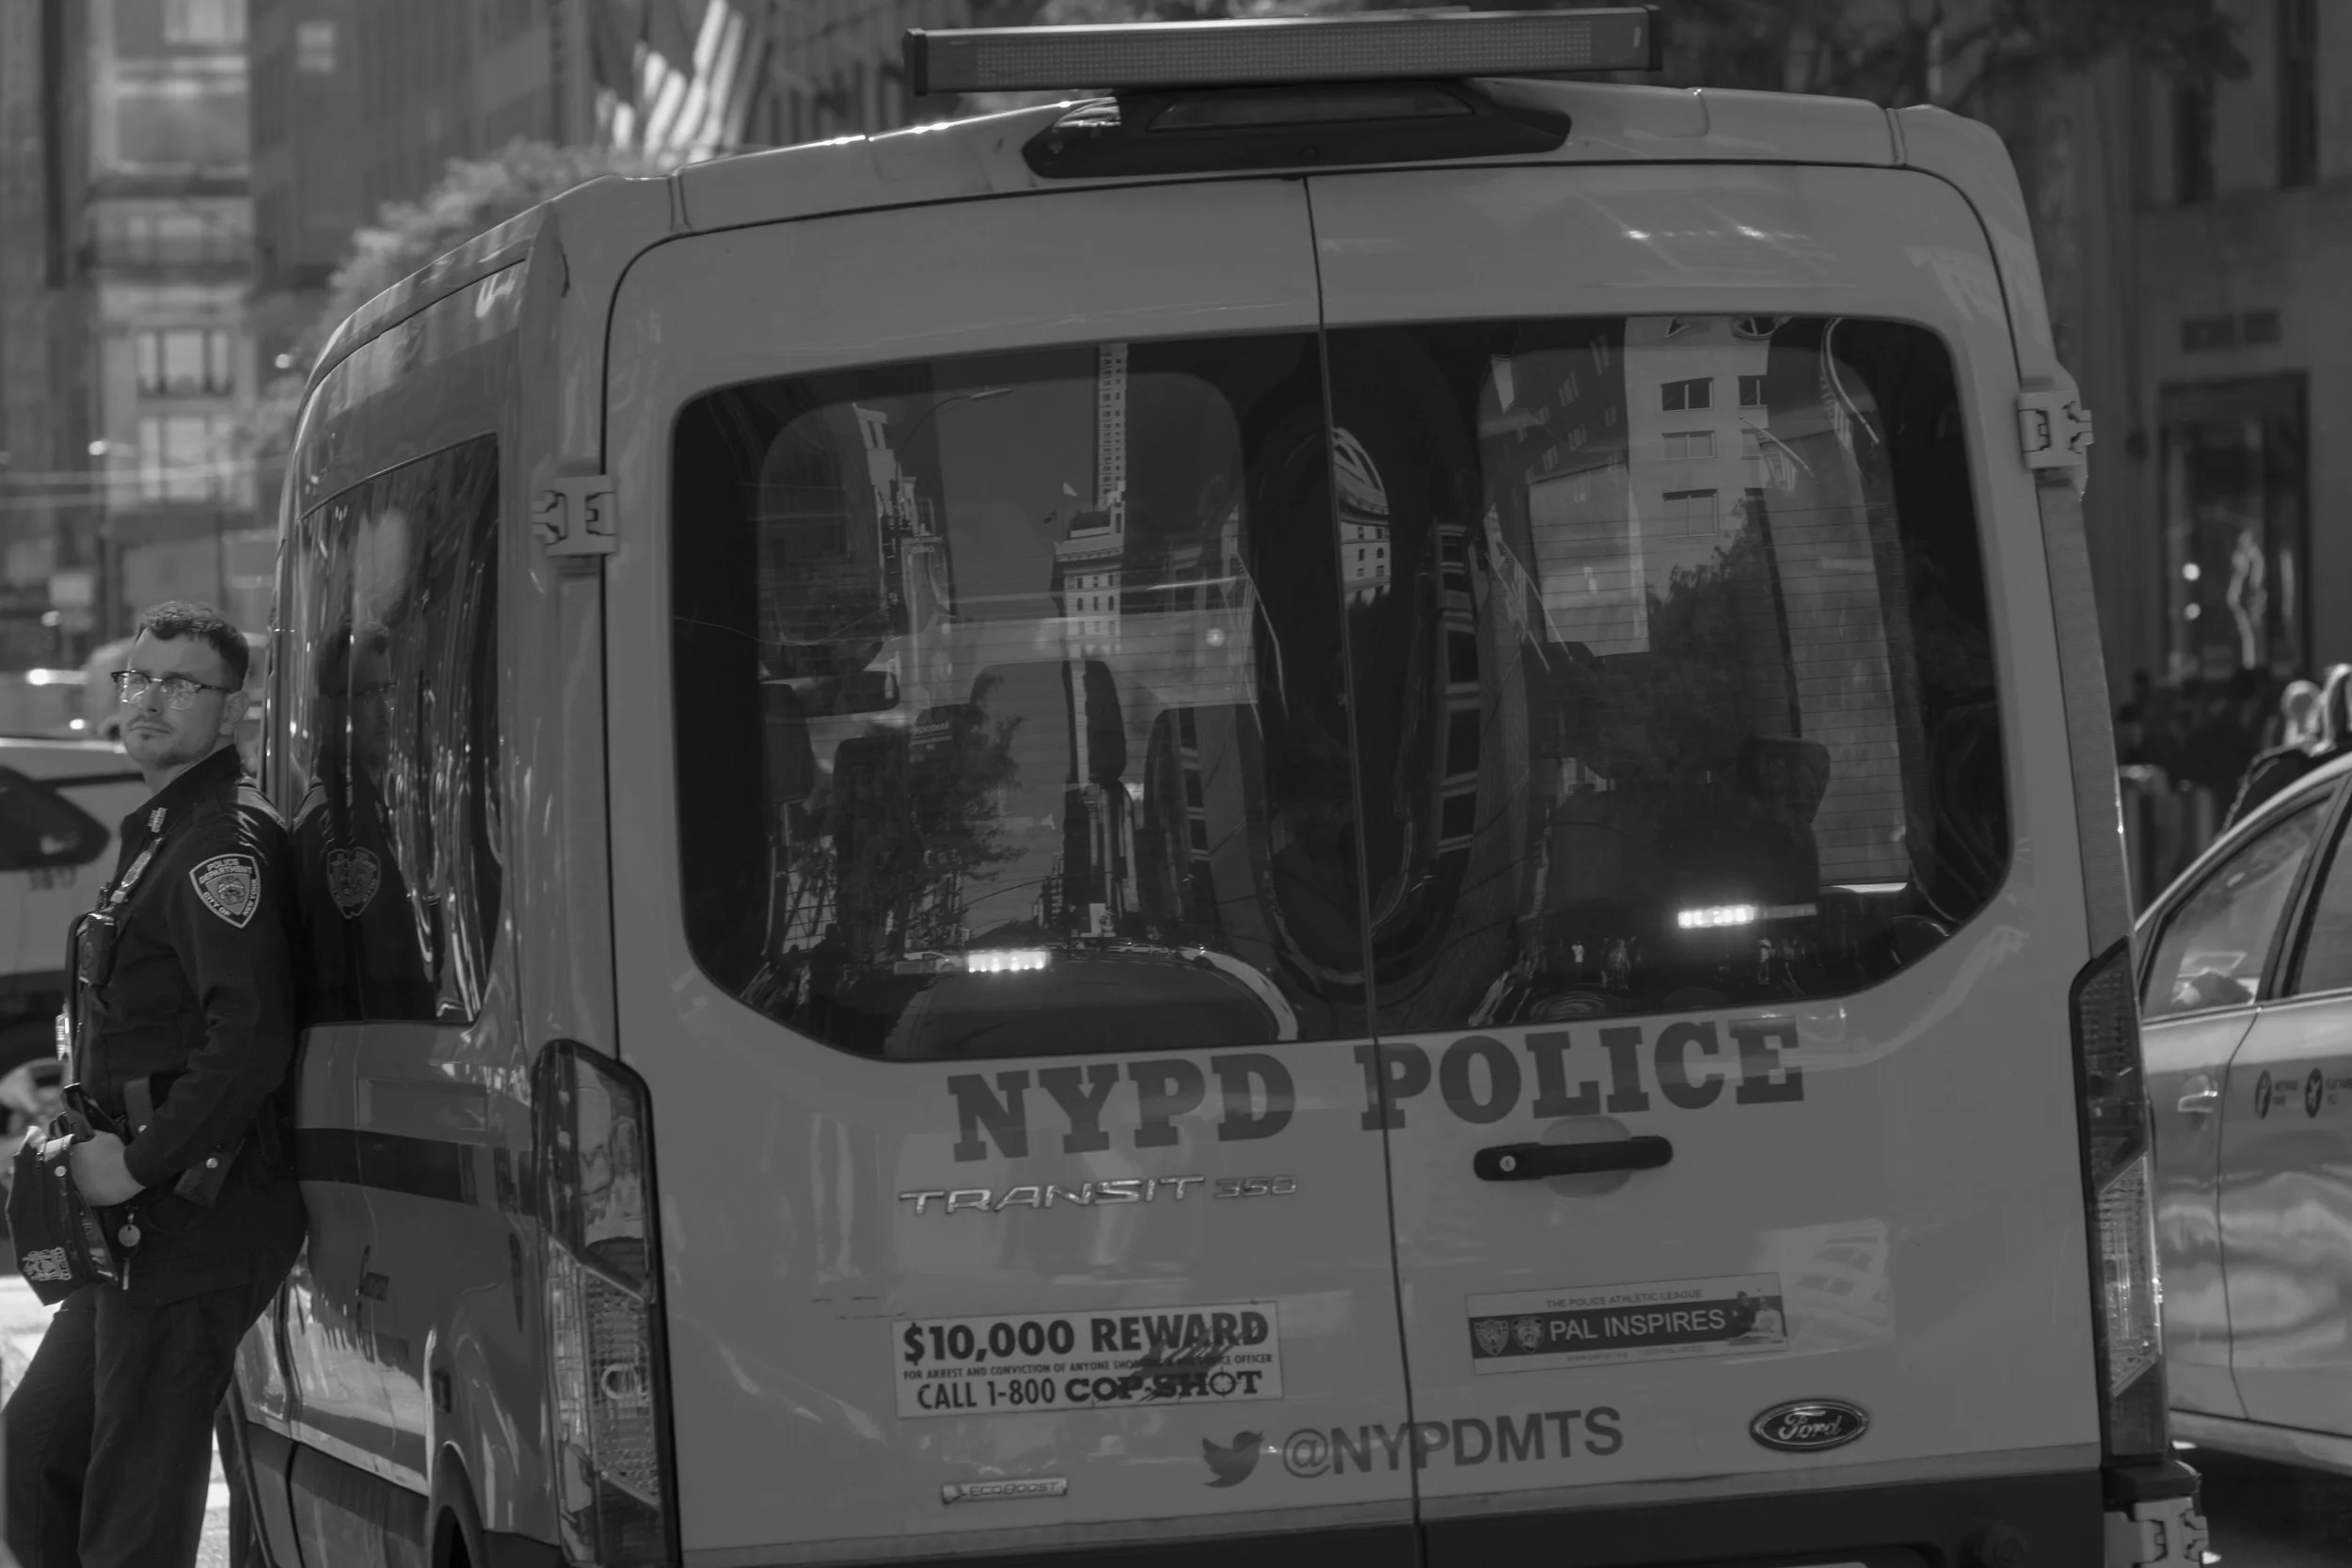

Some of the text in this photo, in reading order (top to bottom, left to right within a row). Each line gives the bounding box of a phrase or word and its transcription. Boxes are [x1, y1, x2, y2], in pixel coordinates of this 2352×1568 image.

[199, 865, 252, 885] DEPARTMENT
[206, 858, 241, 871] POLICE
[947, 1016, 1804, 1163] NYPD POLICE
[898, 1174, 1298, 1217] TRANSIT 350
[1546, 1290, 1704, 1309] THE POLICE ATHLETIC LEAGUE
[903, 1311, 1269, 1366] $10,000 REWARD
[1549, 1308, 1726, 1341] PAL INSPIRES
[903, 1370, 923, 1380] FOR
[927, 1368, 963, 1379] ARREST
[966, 1366, 988, 1376] AND
[990, 1364, 1051, 1376] CONVICTION
[1053, 1363, 1066, 1373] OF
[1070, 1360, 1110, 1371] ANYONE
[1234, 1354, 1273, 1364] OFFICER
[917, 1382, 977, 1410] CALL
[987, 1377, 1056, 1406] 1-800
[1777, 1409, 1843, 1441] Ford
[1282, 1405, 1624, 1479] @NYPDMTS
